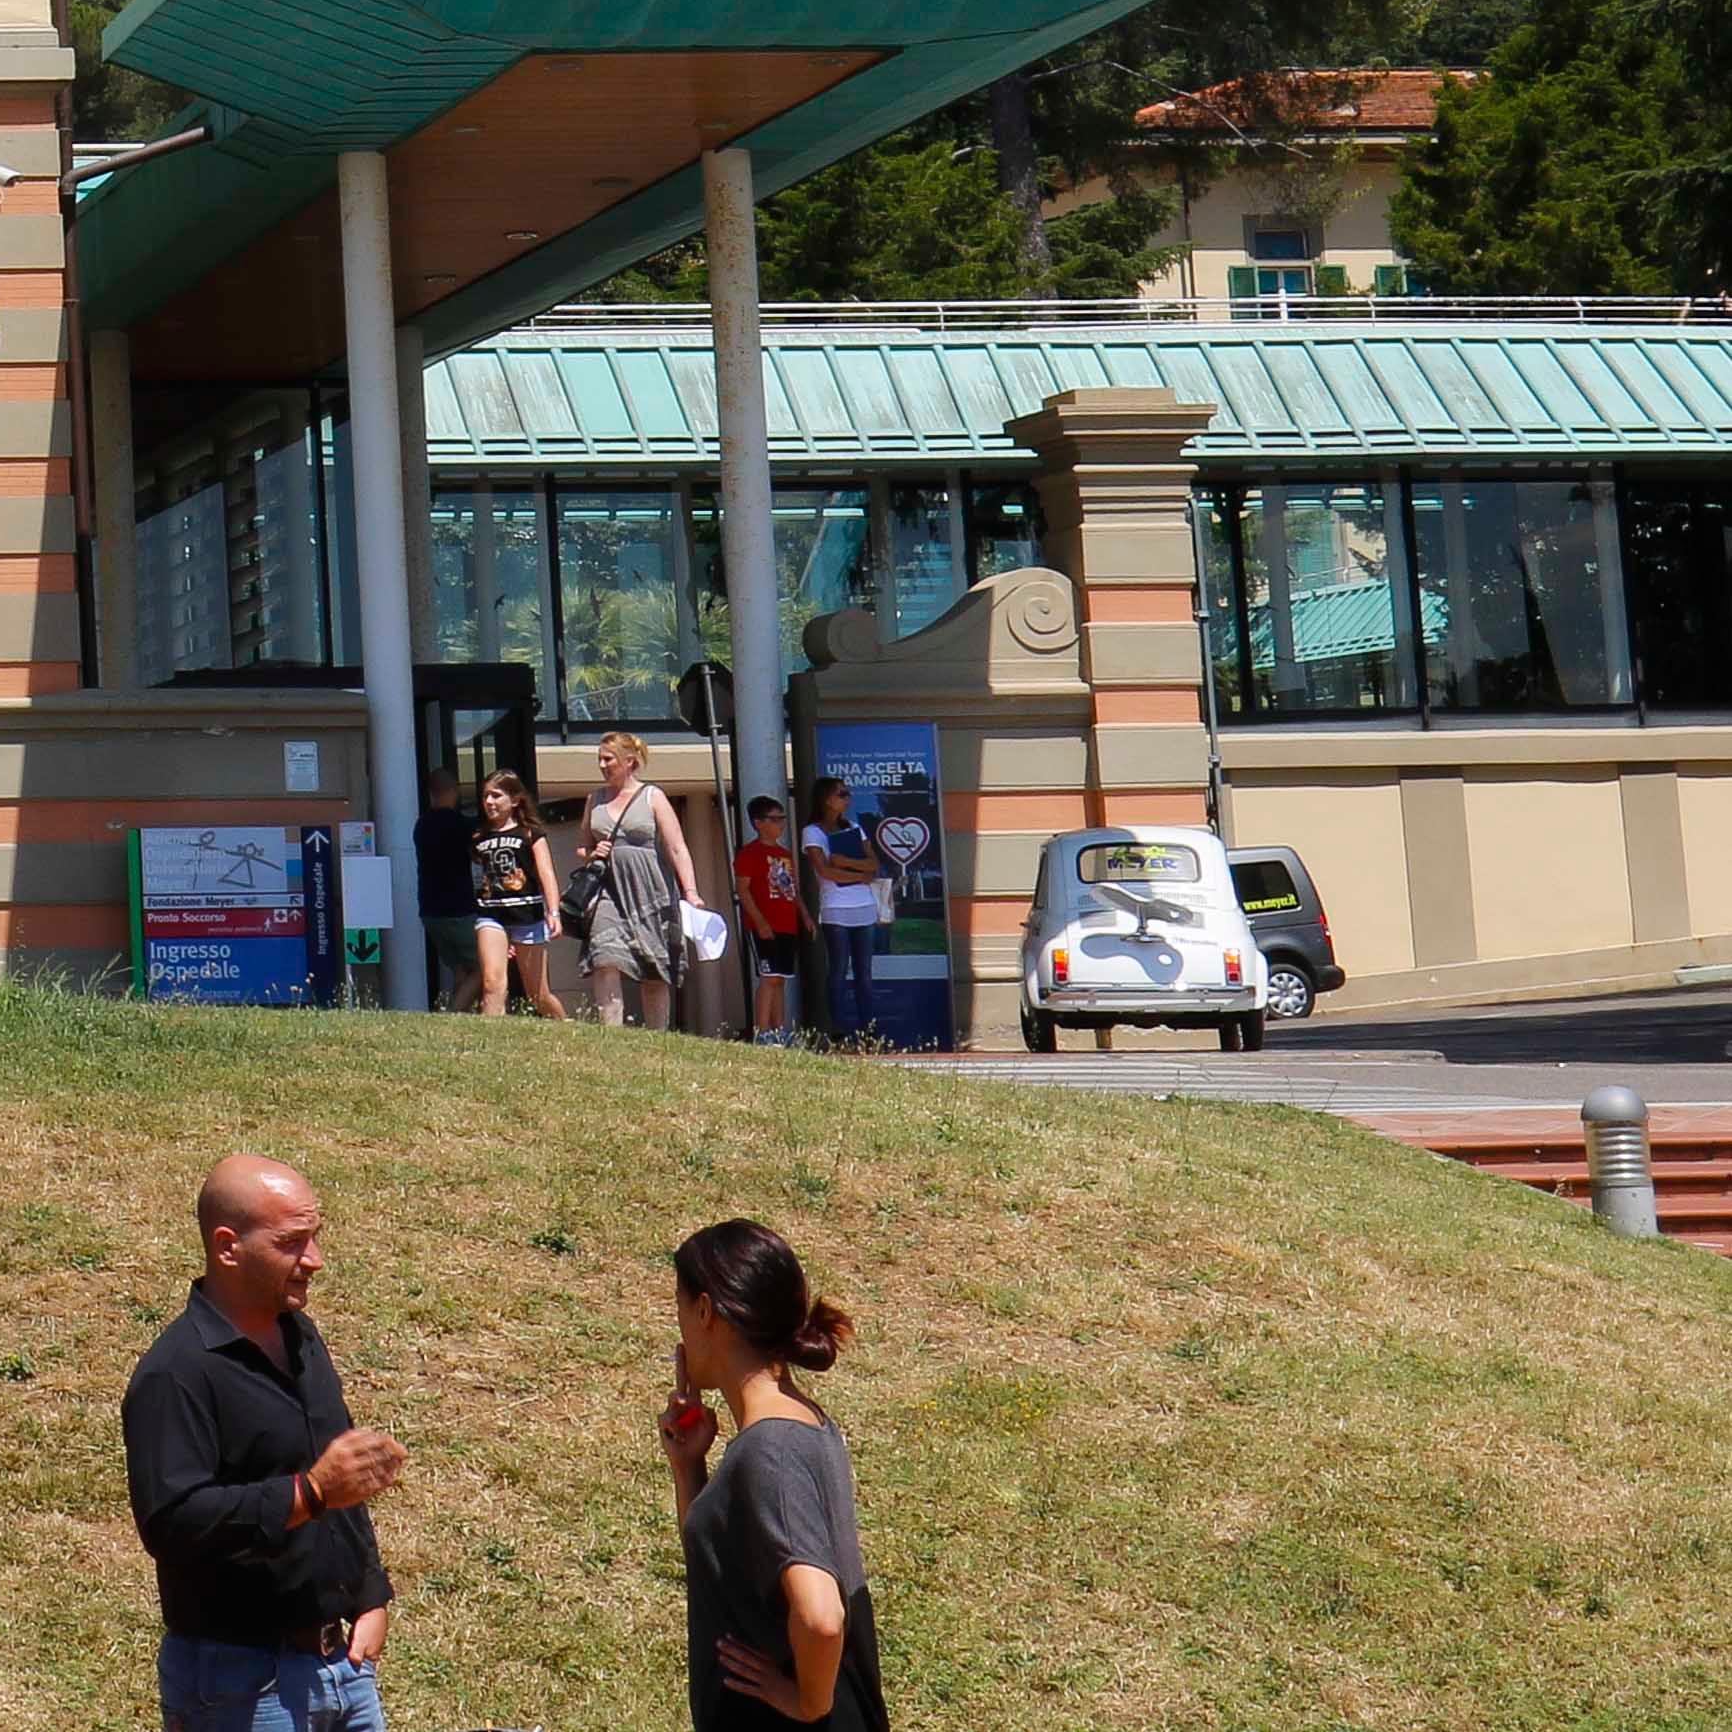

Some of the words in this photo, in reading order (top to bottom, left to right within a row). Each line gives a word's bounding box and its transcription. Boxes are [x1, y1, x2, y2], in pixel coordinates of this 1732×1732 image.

[827, 763, 862, 774] UNA
[865, 762, 927, 774] SCELTA
[832, 774, 904, 786] 'AMORE
[314, 862, 326, 908] Ospedale
[147, 896, 201, 907] Fondazione
[205, 896, 235, 908] Meyer
[147, 913, 179, 923] Pronto
[182, 912, 226, 923] Soccorso
[317, 913, 328, 955] Ingresso
[150, 942, 231, 963] Ingresso
[150, 962, 240, 983] Ospedale
